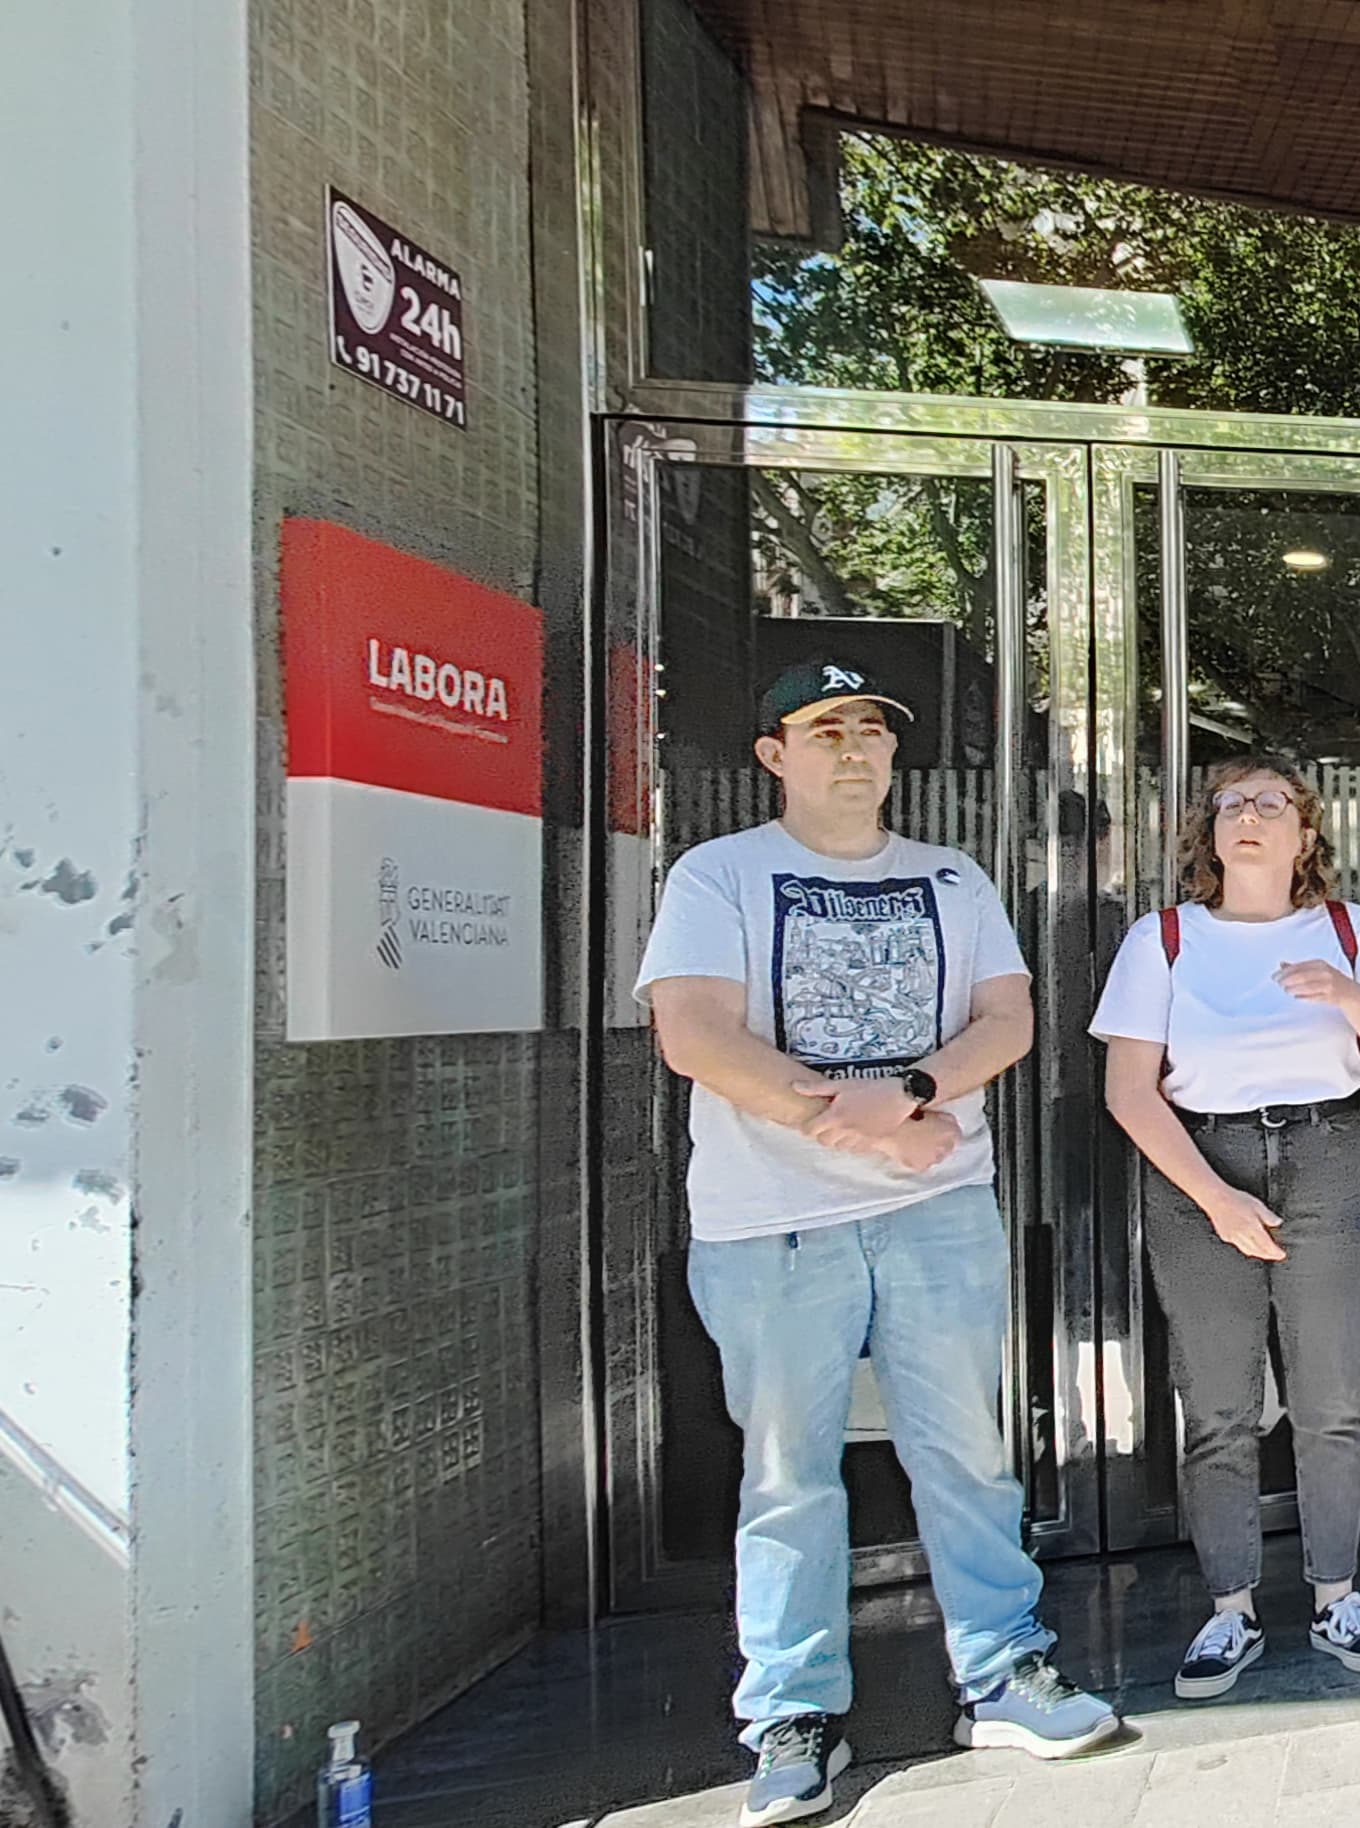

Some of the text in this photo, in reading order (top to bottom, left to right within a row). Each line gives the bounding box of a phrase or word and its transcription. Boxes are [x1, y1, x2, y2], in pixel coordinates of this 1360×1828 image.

[390, 238, 461, 300] ALARMA
[400, 286, 462, 361] 24h
[356, 345, 381, 380] 91
[384, 360, 421, 400] 737
[423, 383, 442, 413] 11
[443, 394, 465, 426] 71
[369, 638, 509, 721] LABORA
[407, 886, 512, 917] GENERALITAT
[408, 919, 511, 945] VALENCIANA
